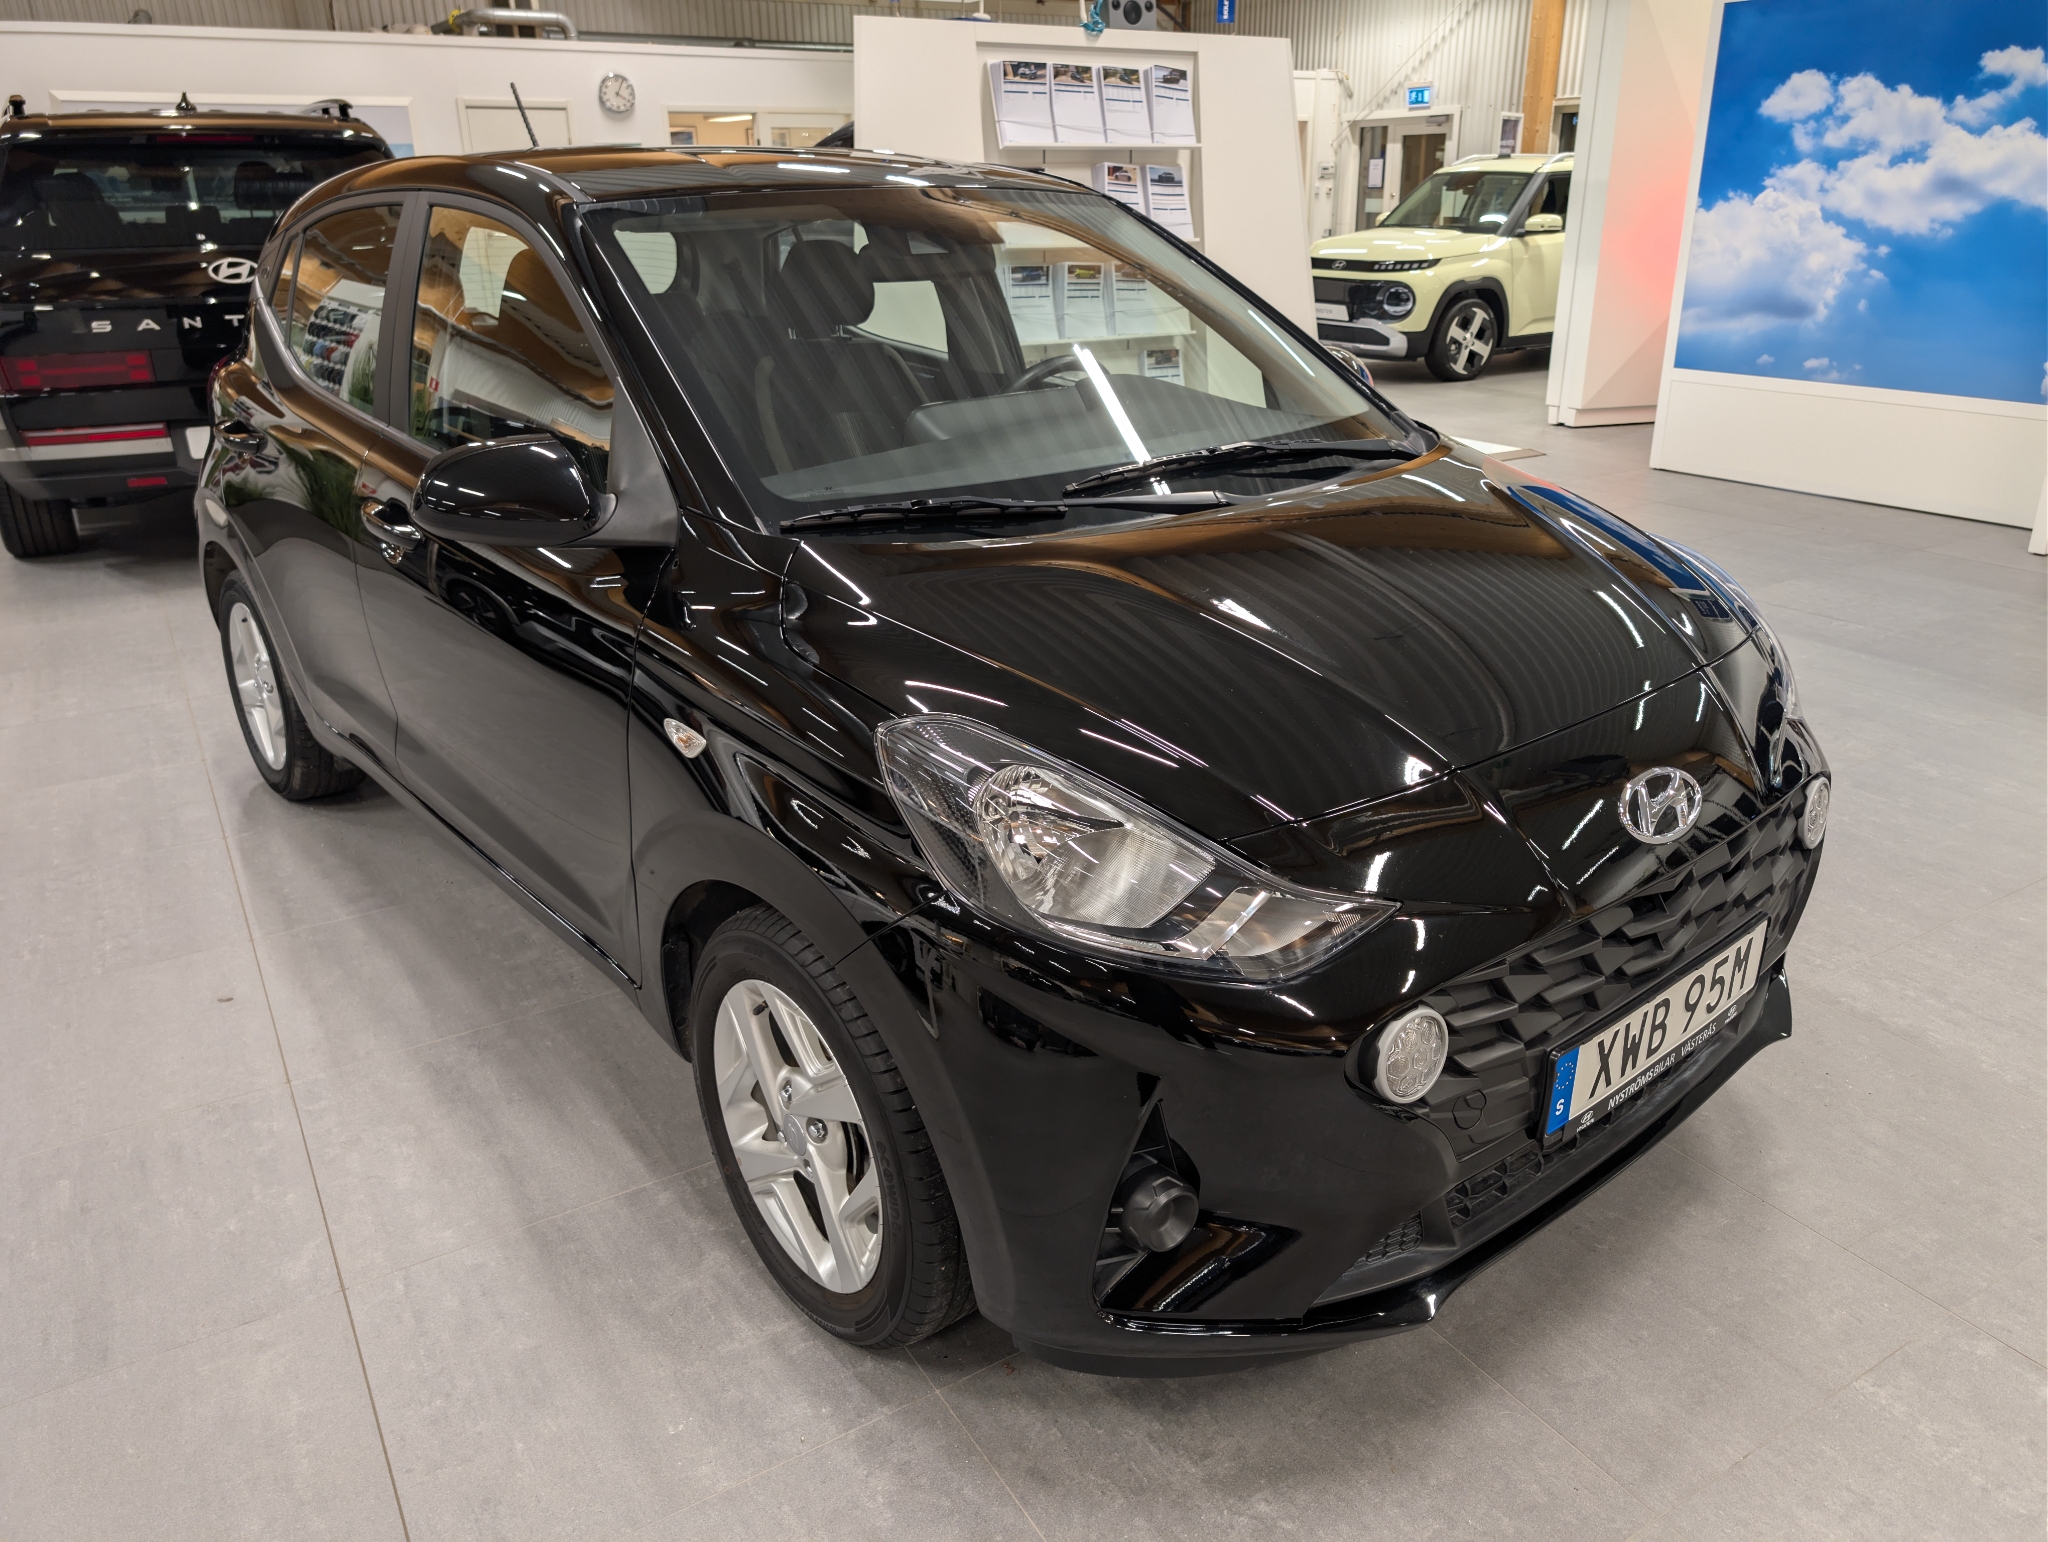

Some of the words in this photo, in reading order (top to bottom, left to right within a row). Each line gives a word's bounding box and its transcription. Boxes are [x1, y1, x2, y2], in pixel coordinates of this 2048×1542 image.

[91, 314, 245, 334] SANT
[1588, 997, 1671, 1100] XWB
[1681, 936, 1754, 1035] 95M
[1607, 1052, 1676, 1111] NYSTRÖMSBILAR
[1681, 1022, 1717, 1057] VÄSTERÅS
[1555, 1098, 1565, 1115] S
